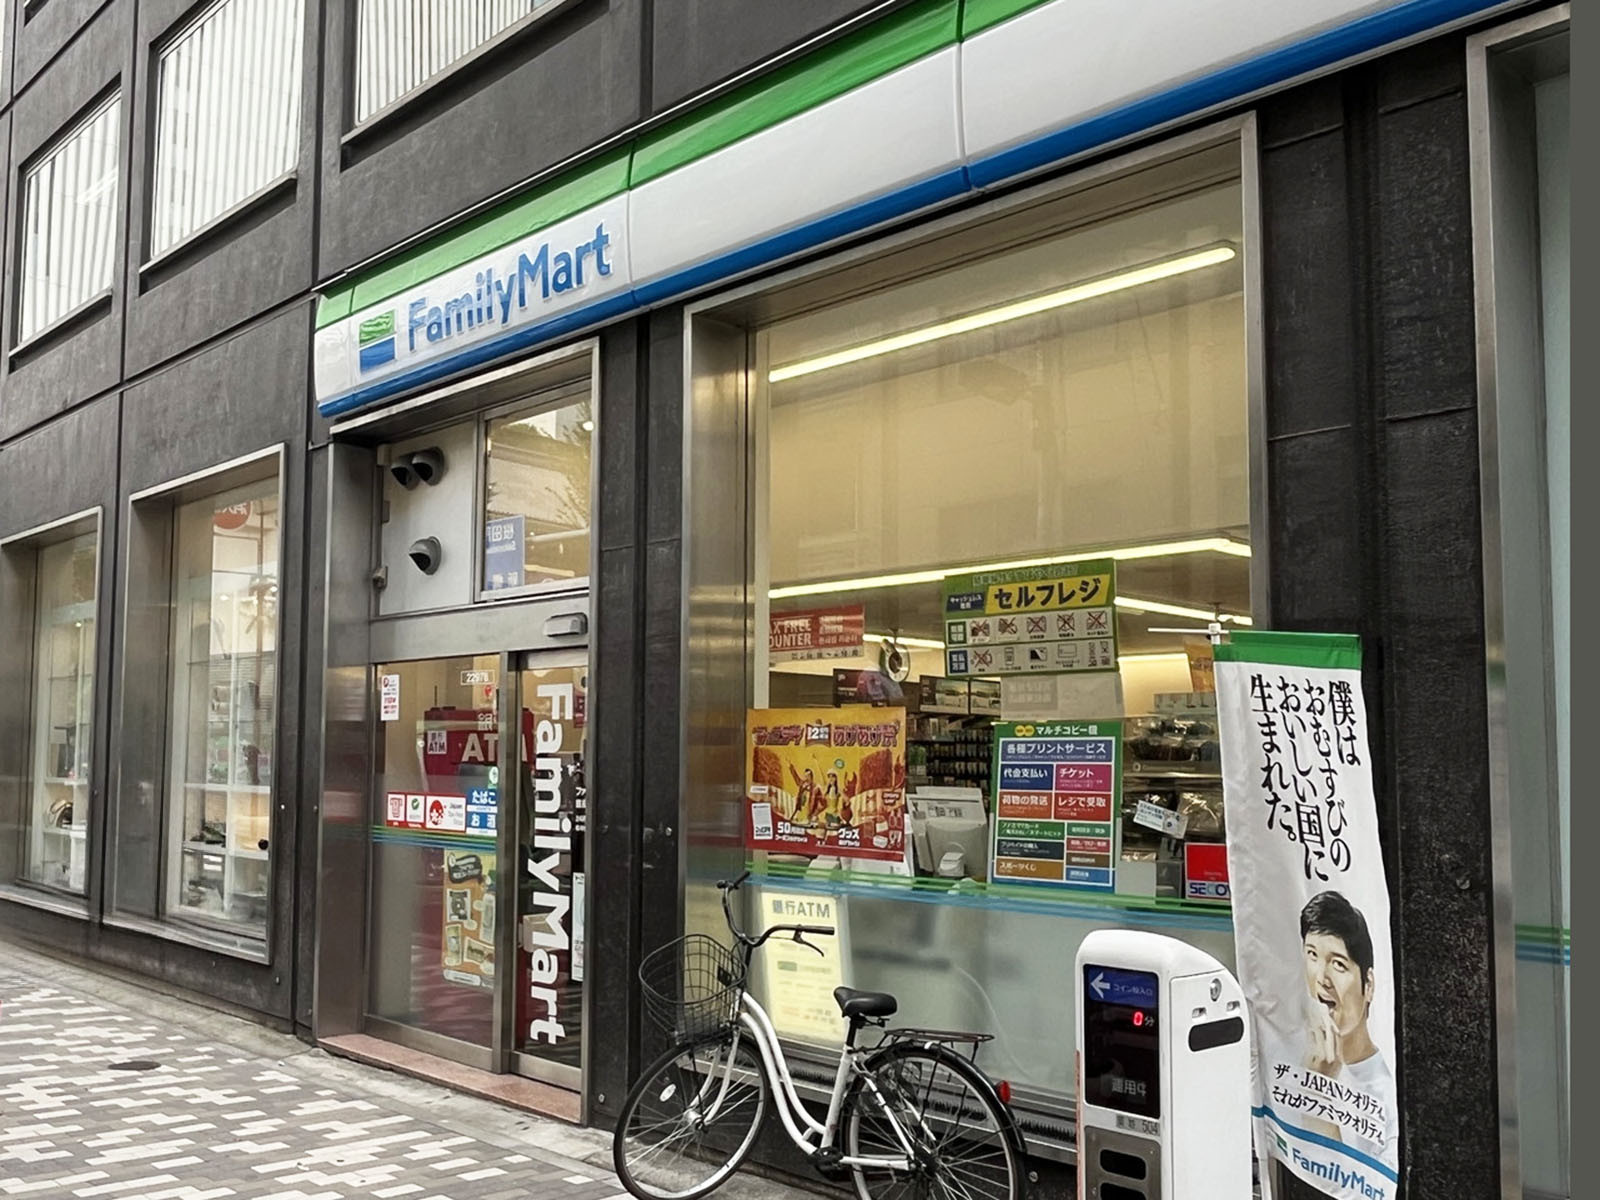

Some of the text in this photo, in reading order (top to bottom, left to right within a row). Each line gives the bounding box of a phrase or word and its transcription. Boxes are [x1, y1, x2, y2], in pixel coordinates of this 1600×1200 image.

[408, 222, 612, 351] FamilyMart
[993, 576, 1102, 610] セルフレジ
[783, 618, 812, 633] FREE
[1328, 680, 1361, 767] 僕は
[428, 742, 447, 753] ATM
[1007, 742, 1107, 755] 各種プリントサービス
[1250, 673, 1297, 842] 生まれた。
[1003, 767, 1048, 779] 代金支払い
[1059, 767, 1094, 779] チケット
[1276, 674, 1329, 882] おいしい国に
[1303, 677, 1352, 873] おむすびの
[471, 790, 497, 805] たばこ
[1001, 794, 1049, 806] 荷物の発送
[1057, 796, 1107, 808] レジで受取
[528, 682, 574, 1045] FamilyMart
[1273, 1063, 1386, 1122] ザ・JAPANクオリティ。
[1271, 1085, 1386, 1147] それがファミマクオリティ。
[1291, 1147, 1386, 1200] FamilyMart
